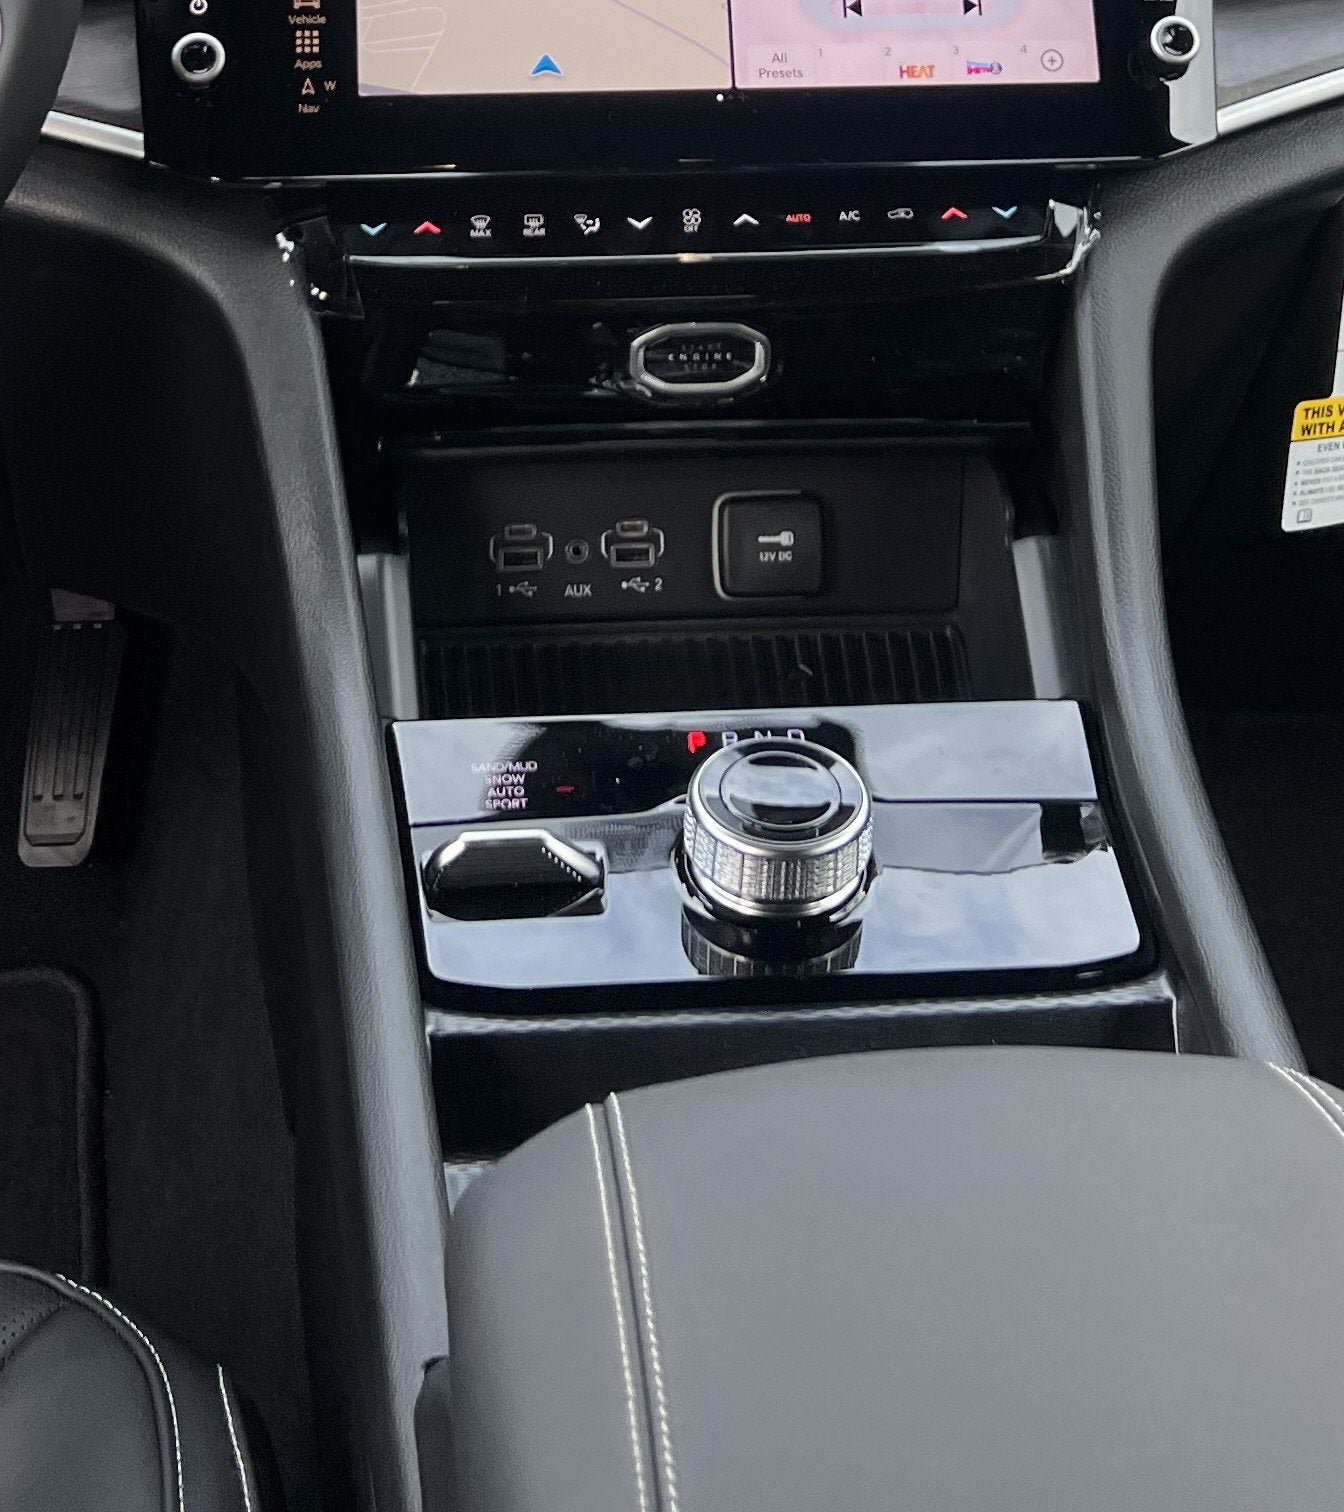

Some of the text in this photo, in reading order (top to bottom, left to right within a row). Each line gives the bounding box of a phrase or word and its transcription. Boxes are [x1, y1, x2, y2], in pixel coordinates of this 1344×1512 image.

[288, 15, 327, 25] Vehicle
[885, 46, 892, 57] 2
[953, 45, 960, 56] 3
[1019, 44, 1027, 55] 4
[771, 52, 788, 64] All
[294, 59, 323, 71] Apps
[758, 67, 804, 80] Presets
[899, 64, 936, 79] HEAT
[324, 81, 337, 91] W
[298, 104, 321, 114] Nav
[786, 214, 812, 224] AUTO
[839, 210, 861, 222] A/C
[470, 228, 492, 237] MAX
[1303, 405, 1333, 420] THIS
[1301, 421, 1335, 437] WITH
[1317, 441, 1340, 453] EVEN
[778, 550, 793, 561] DC
[565, 584, 592, 597] AUX
[654, 578, 663, 591] 2
[688, 730, 706, 754] P
[471, 760, 538, 773] SAND/MUD
[485, 773, 526, 786] SNOW
[488, 786, 525, 798] AUTO
[485, 798, 528, 809] SPORT
